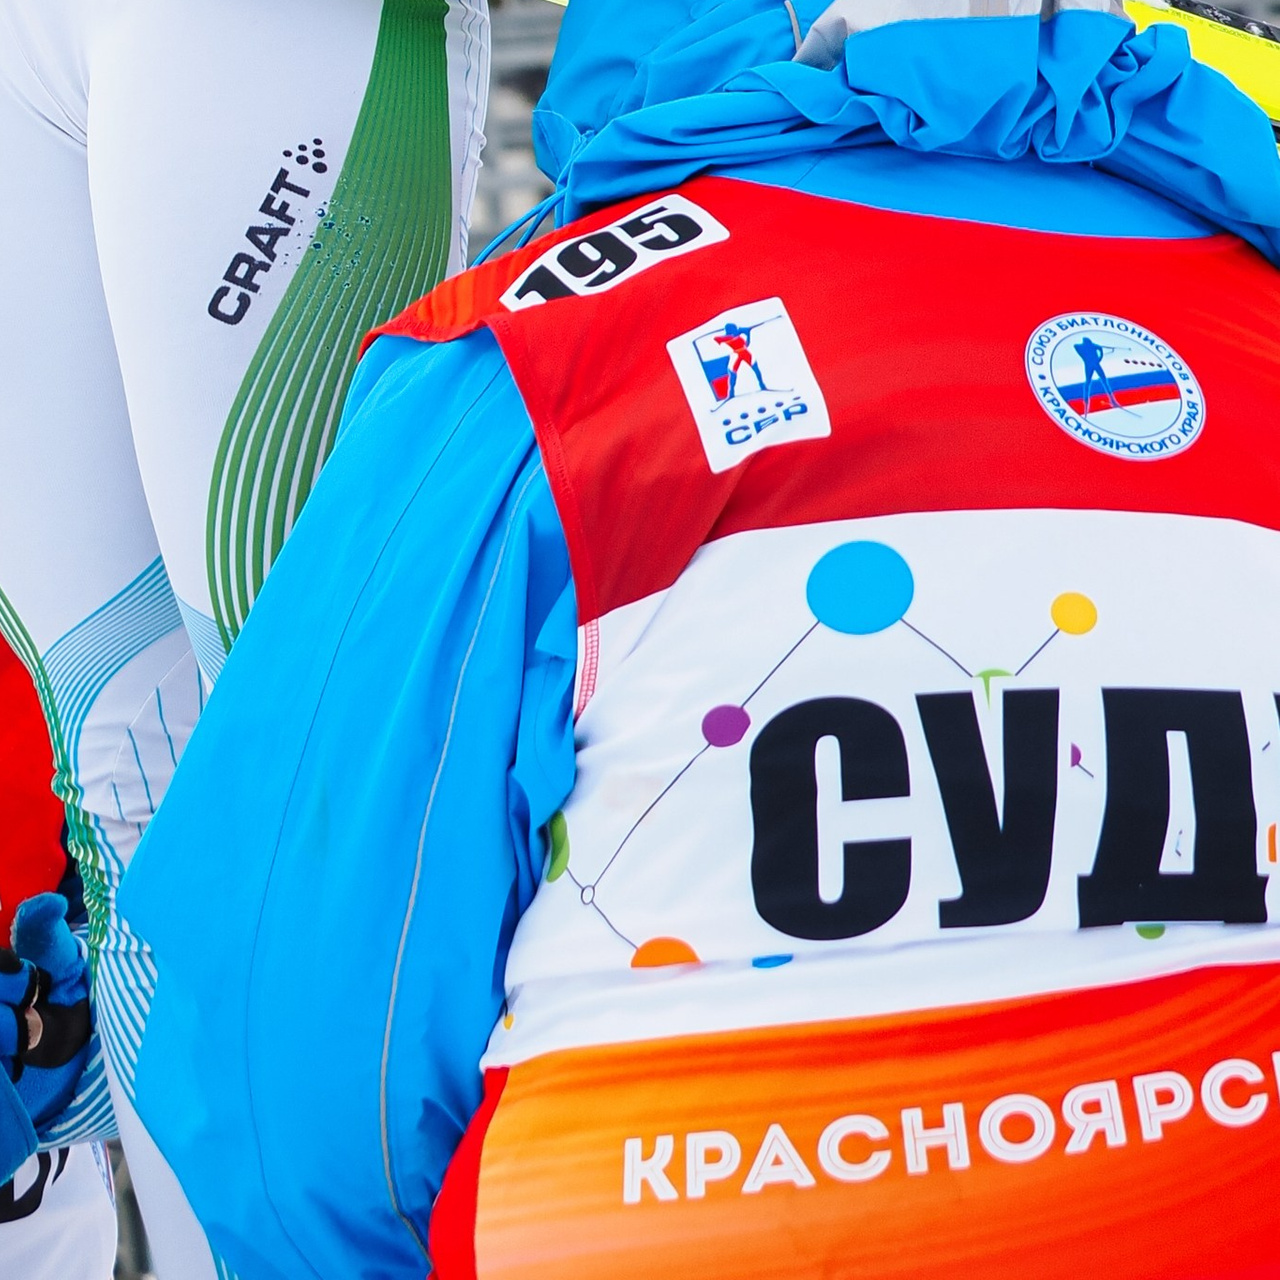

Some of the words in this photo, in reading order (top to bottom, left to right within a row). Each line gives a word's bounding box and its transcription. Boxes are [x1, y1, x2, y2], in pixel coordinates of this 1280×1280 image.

[208, 167, 311, 326] CRAFT
[514, 196, 704, 301] 195
[1032, 327, 1058, 366] СОЮЗ
[1056, 317, 1189, 381] БИАТЛОНИСТОВ
[1039, 386, 1182, 454] КРАСНОЯРСКОГО
[1179, 401, 1200, 437] КРАЯ
[749, 686, 1280, 941] СУД
[622, 1051, 1280, 1204] КРАСНОЯРС
